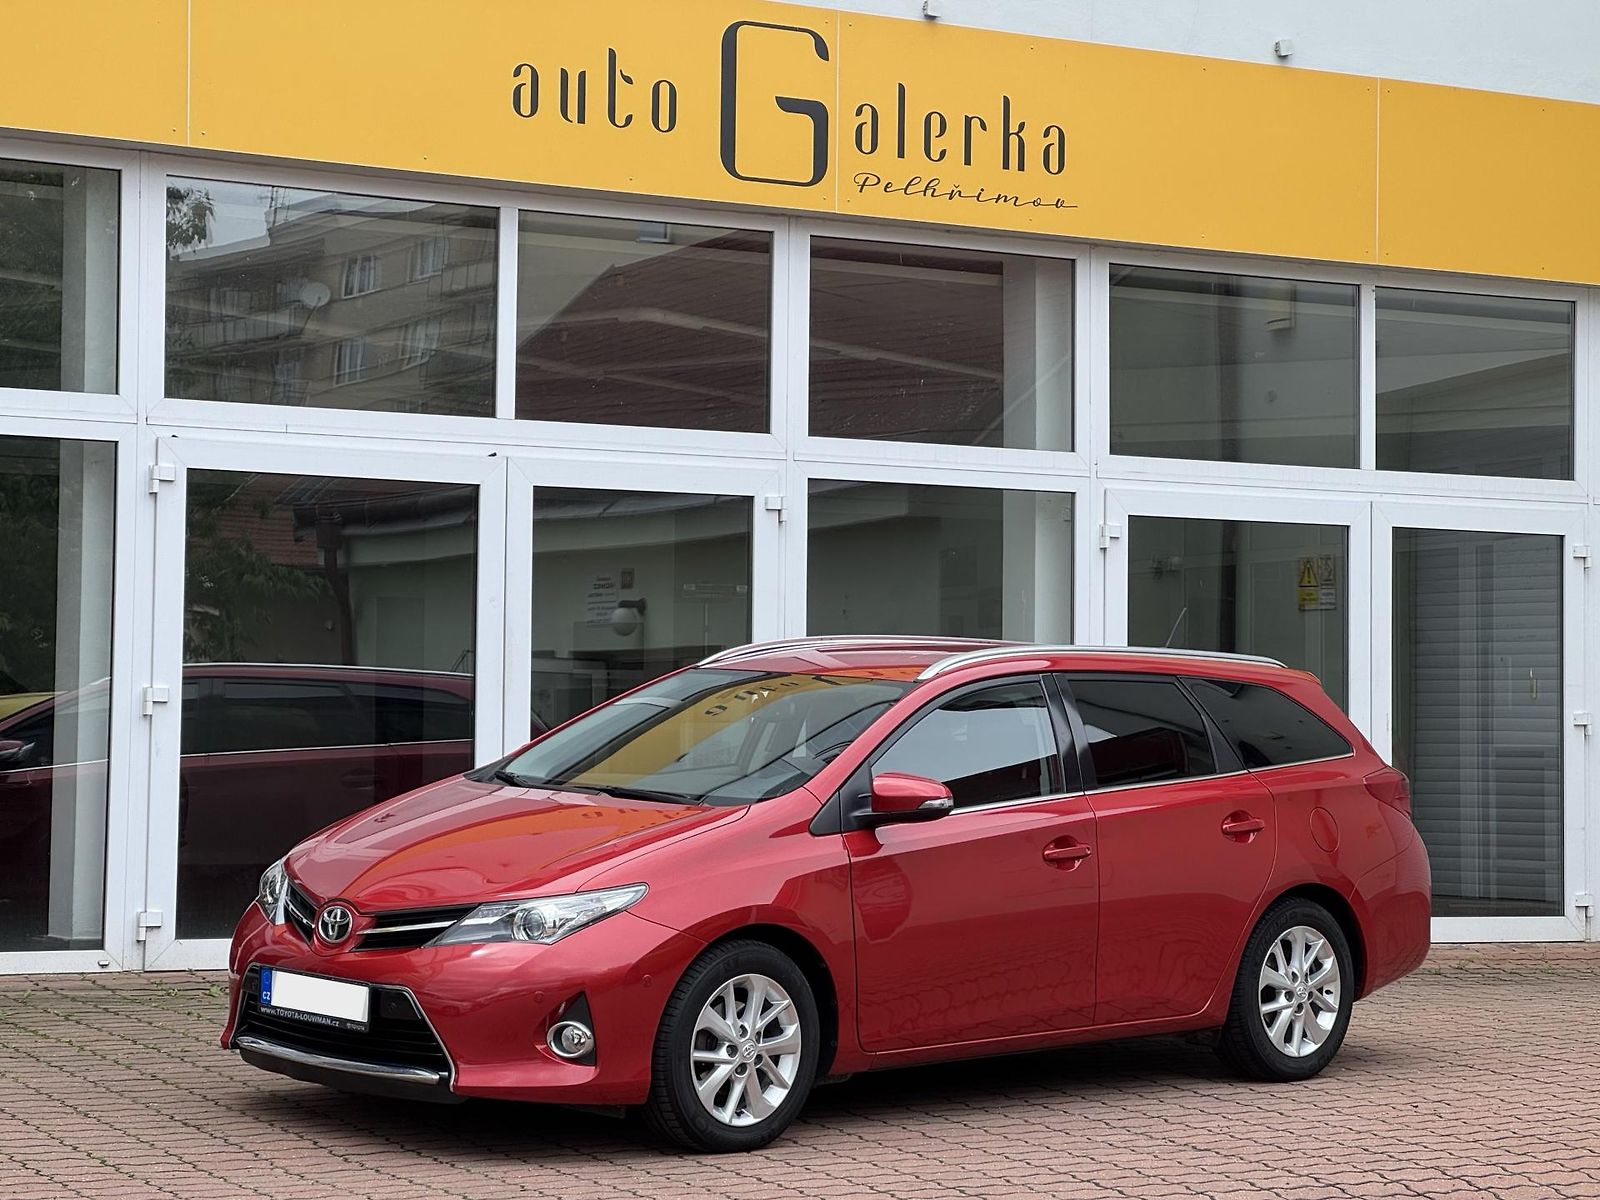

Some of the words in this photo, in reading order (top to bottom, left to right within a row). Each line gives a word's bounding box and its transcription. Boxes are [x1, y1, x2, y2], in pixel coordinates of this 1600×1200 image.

[512, 47, 678, 134] auto
[719, 20, 1067, 188] Galerka
[853, 171, 1079, 210] Pelhřimov
[262, 991, 271, 1000] CZ
